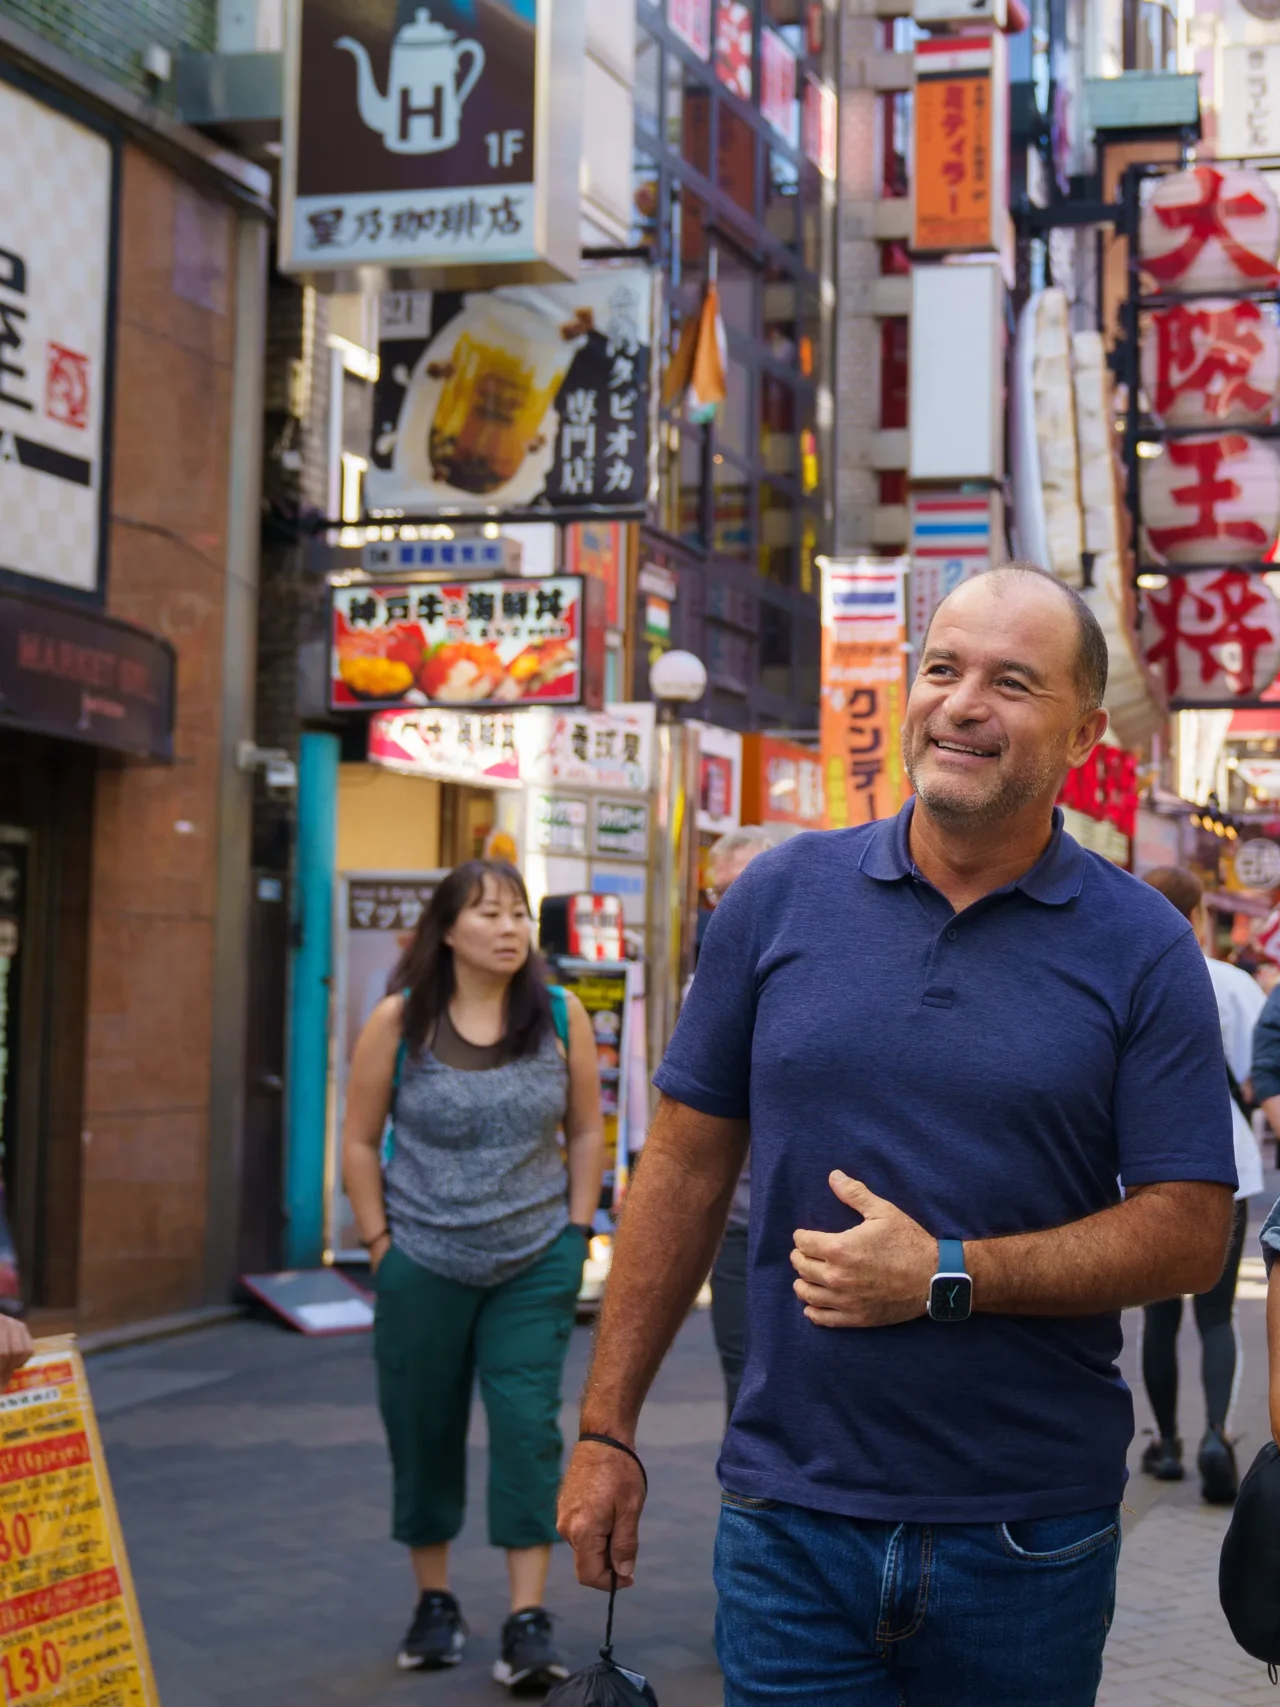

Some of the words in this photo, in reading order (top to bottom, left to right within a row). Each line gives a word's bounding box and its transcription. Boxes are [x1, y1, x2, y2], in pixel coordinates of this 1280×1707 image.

[399, 84, 443, 142] H
[484, 129, 524, 168] 1F
[306, 195, 524, 250] 星乃珈琲店
[561, 389, 597, 495] 専門店
